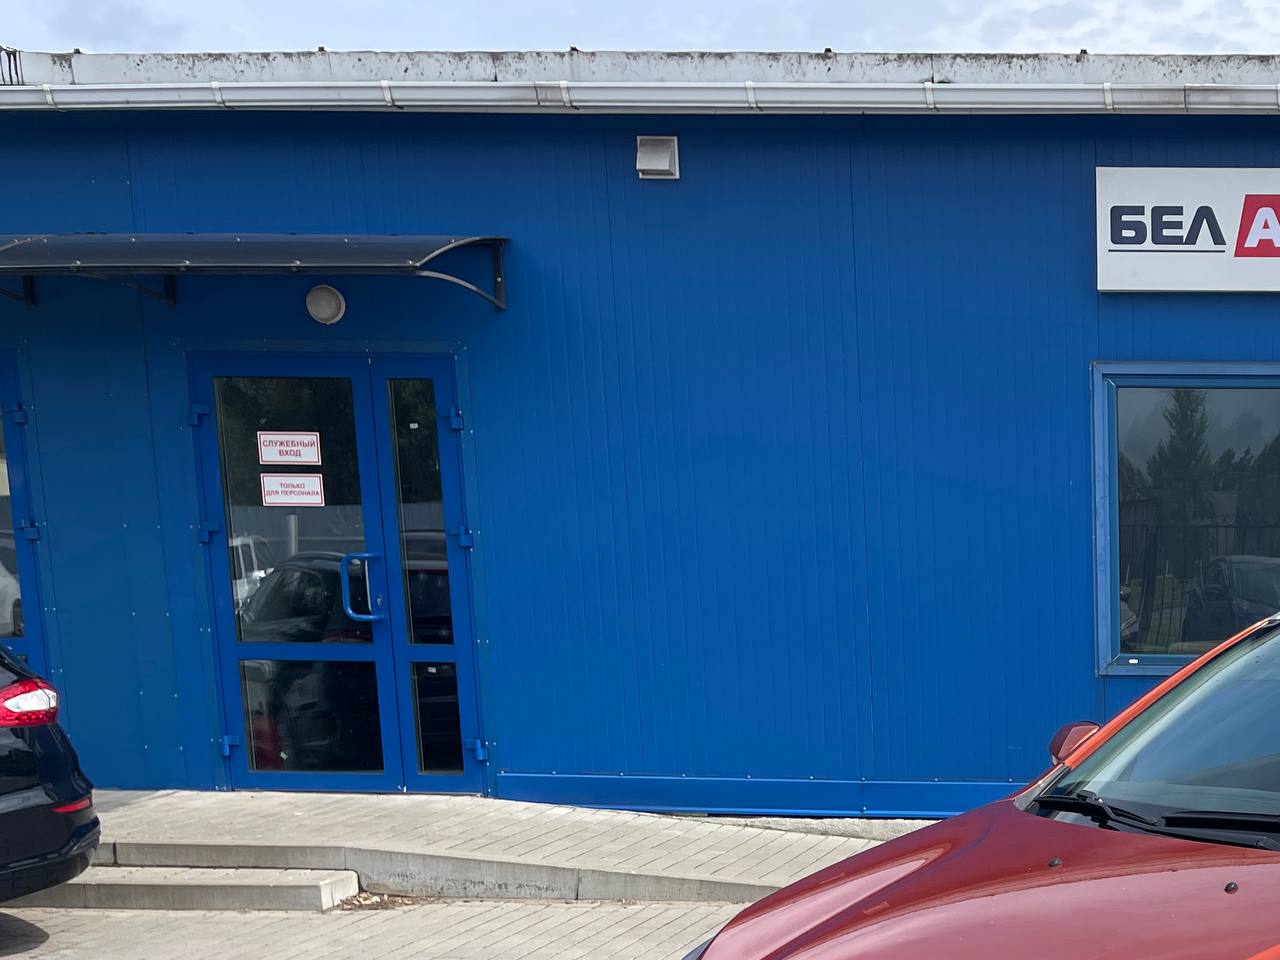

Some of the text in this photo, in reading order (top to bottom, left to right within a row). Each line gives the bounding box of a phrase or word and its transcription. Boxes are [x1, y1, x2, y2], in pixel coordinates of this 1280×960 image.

[1109, 204, 1226, 246] БЕЛ
[262, 439, 316, 448] СЛУЖЕБНЫЙ
[278, 449, 302, 458] ВХОД
